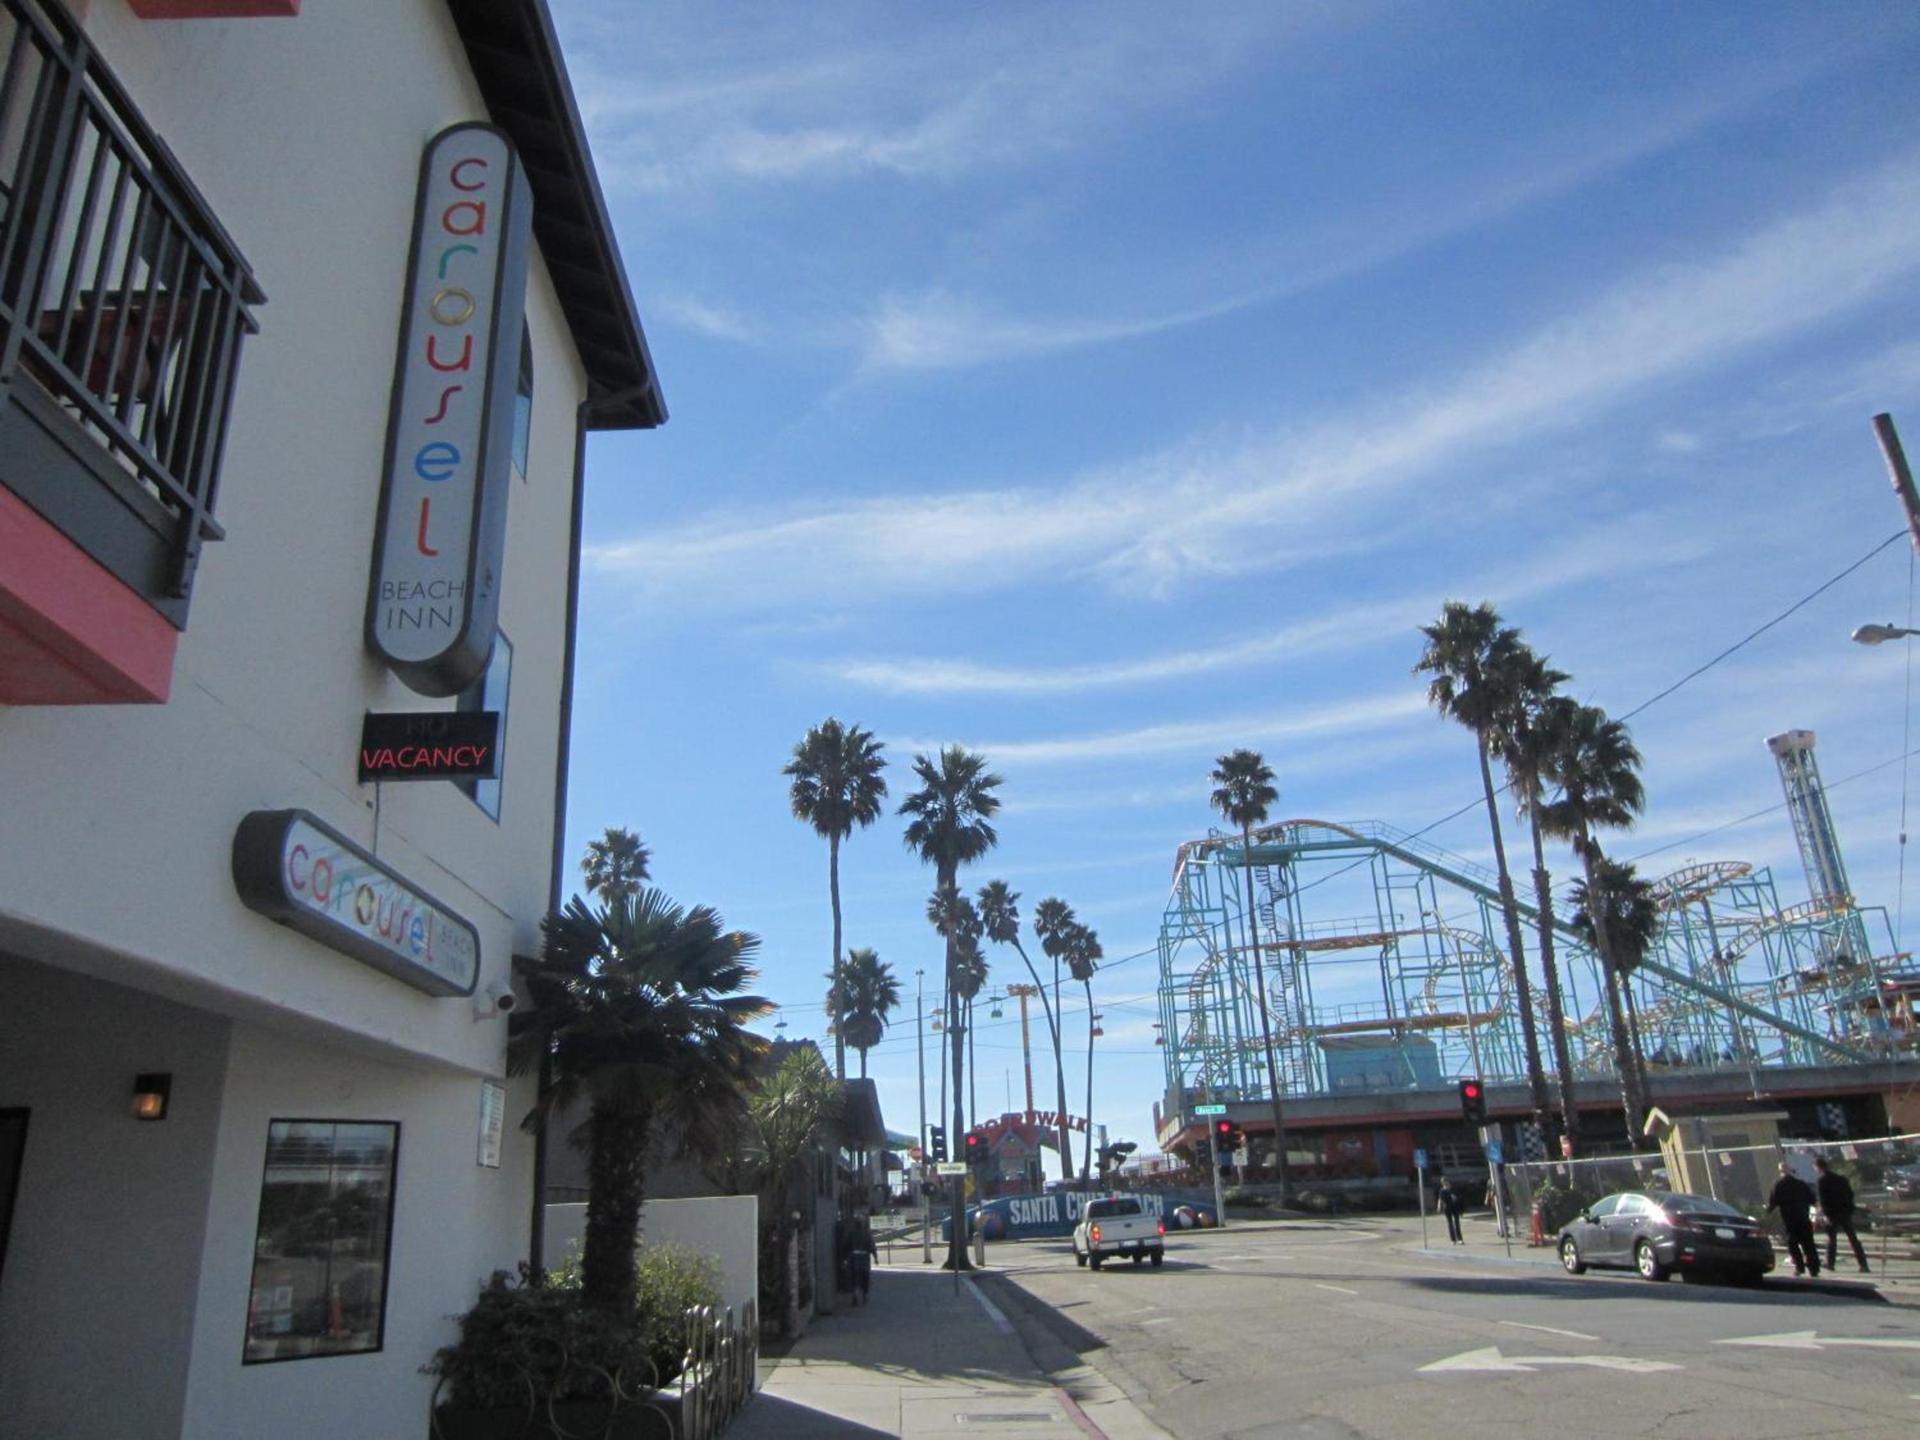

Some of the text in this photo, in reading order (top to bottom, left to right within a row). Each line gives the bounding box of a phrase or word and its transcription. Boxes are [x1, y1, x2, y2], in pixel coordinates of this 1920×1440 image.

[415, 158, 488, 557] carousel
[382, 580, 465, 600] BEACH
[386, 606, 453, 630] INN
[362, 745, 488, 769] VACANCY
[1009, 1190, 1164, 1225] SANTA CR ACH
